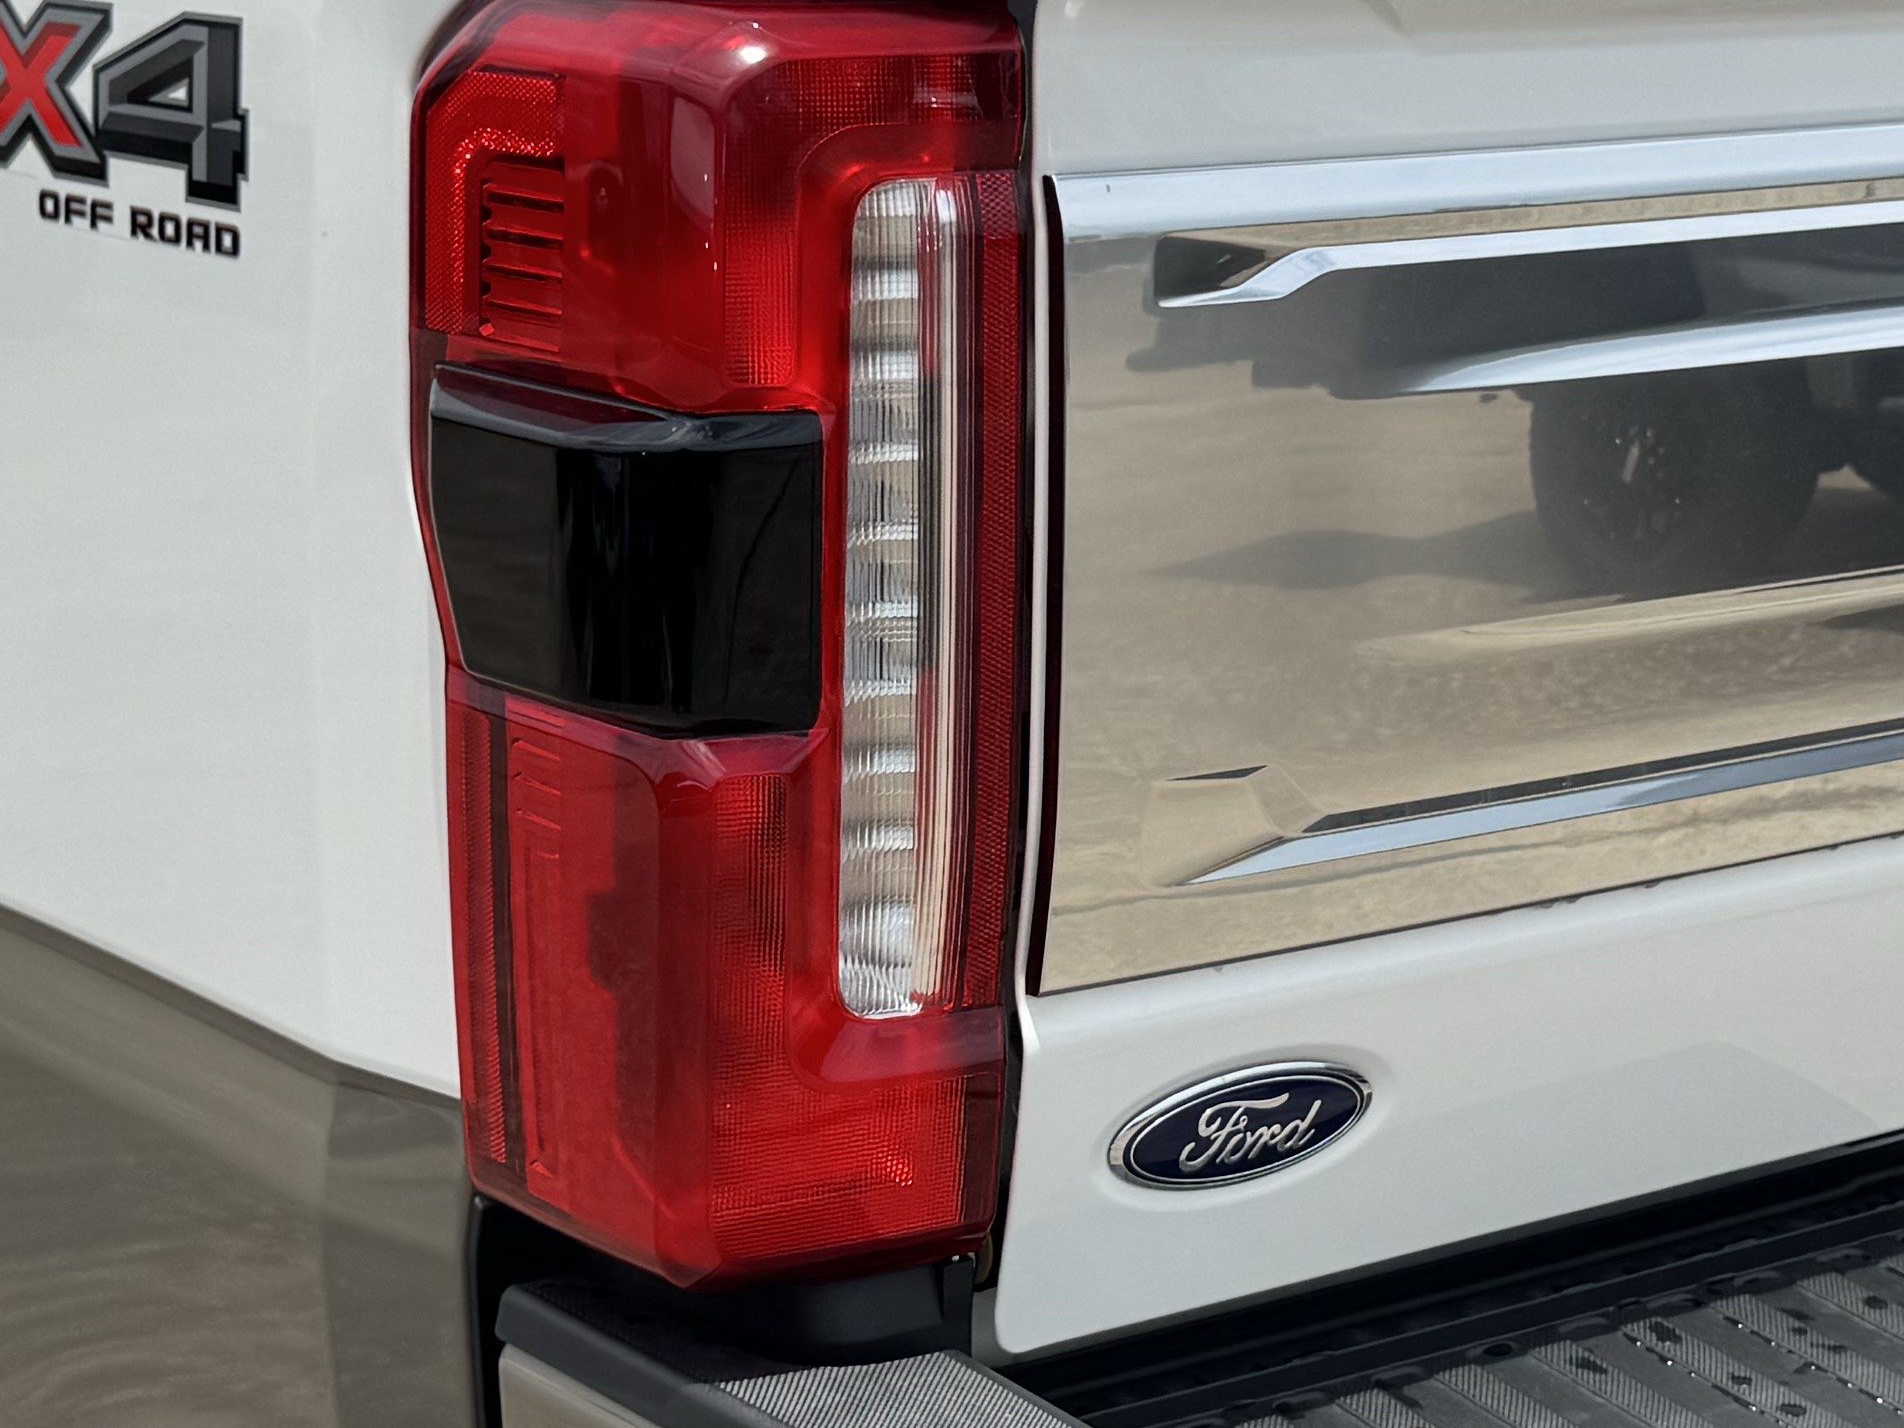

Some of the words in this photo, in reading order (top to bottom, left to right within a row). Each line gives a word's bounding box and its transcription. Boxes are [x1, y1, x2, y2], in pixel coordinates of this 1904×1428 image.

[37, 188, 114, 233] OFF
[129, 204, 242, 259] ROAD
[1178, 1091, 1323, 1173] Ford
